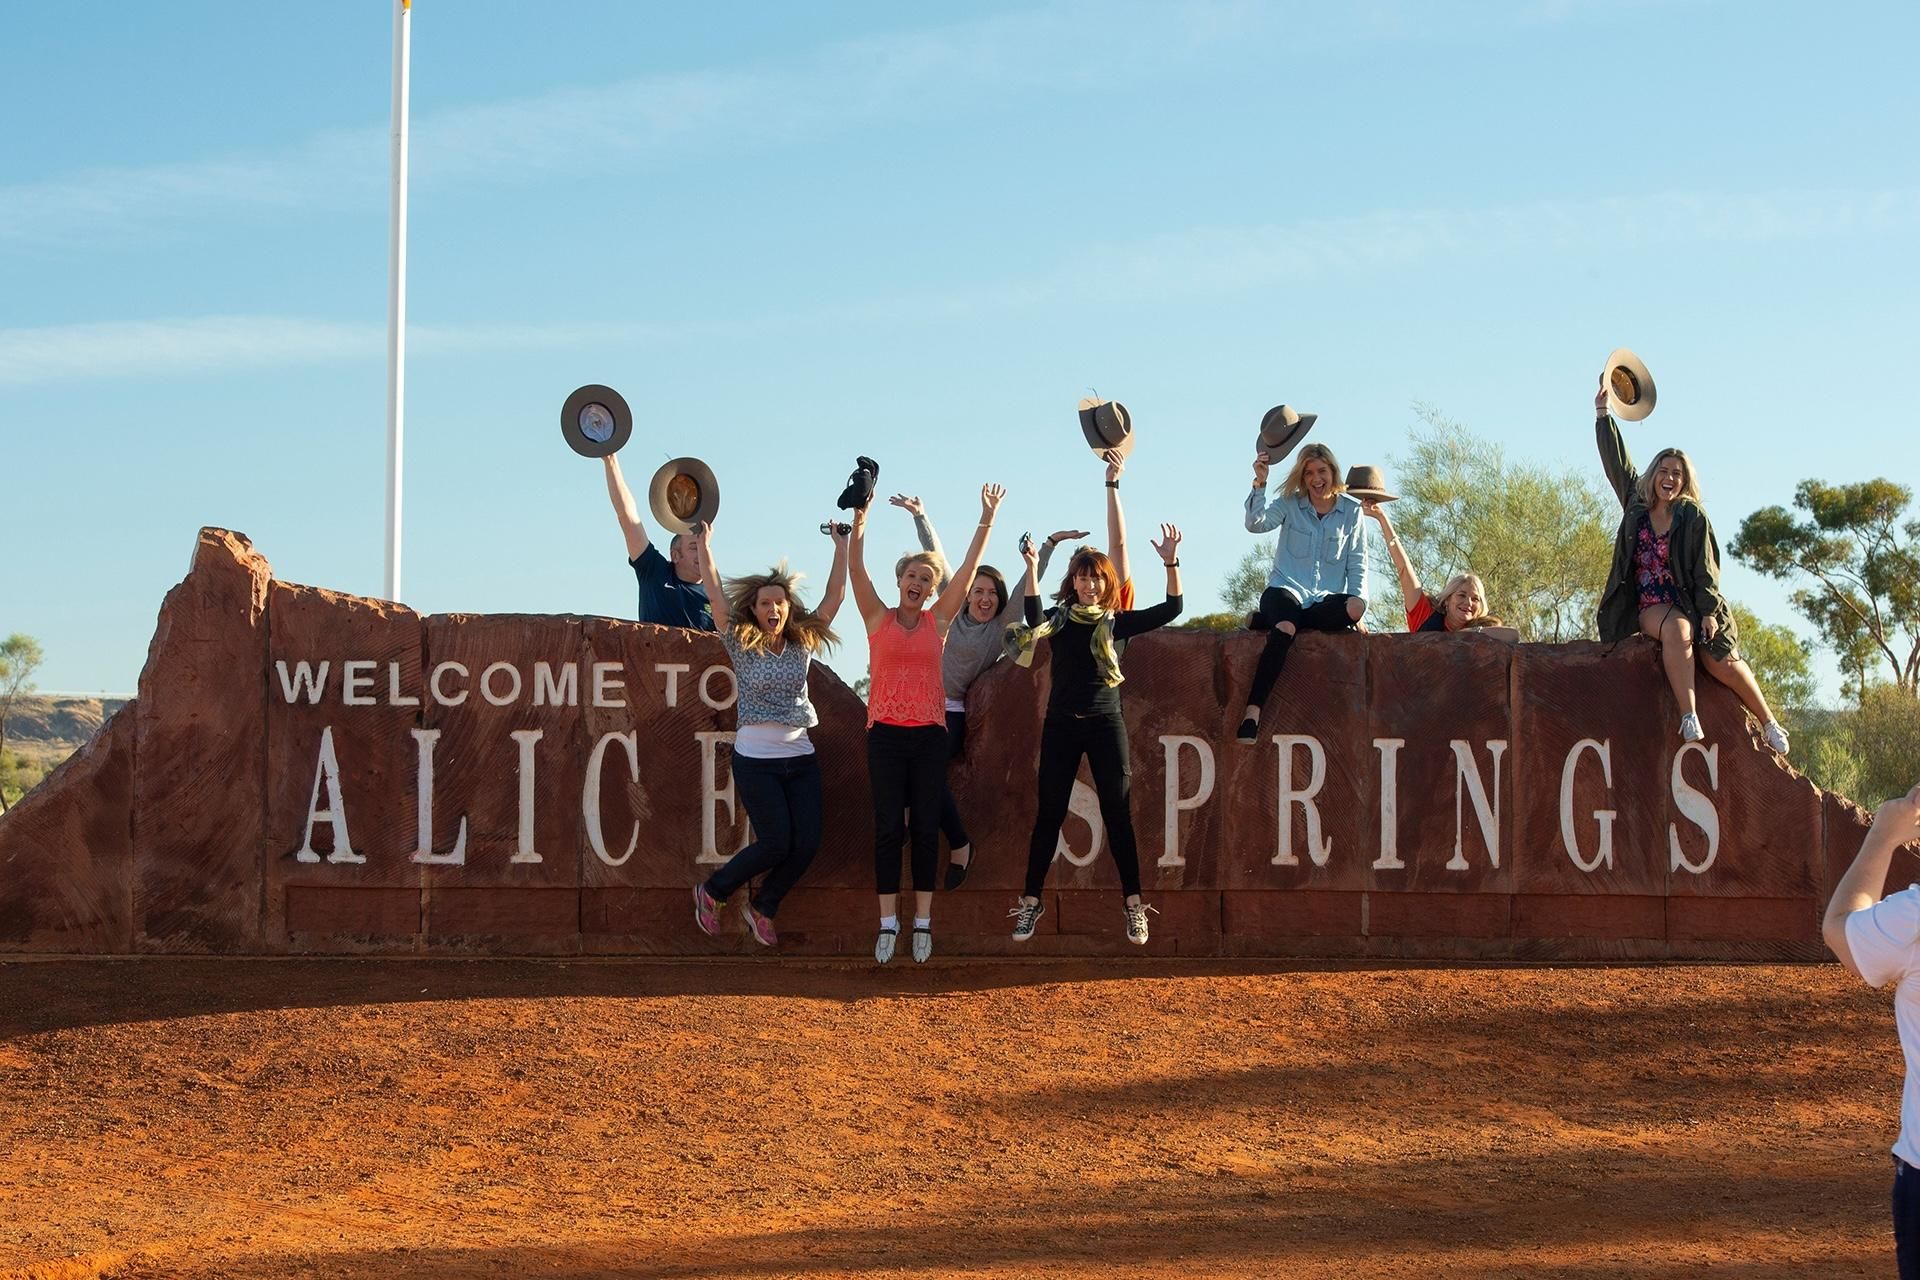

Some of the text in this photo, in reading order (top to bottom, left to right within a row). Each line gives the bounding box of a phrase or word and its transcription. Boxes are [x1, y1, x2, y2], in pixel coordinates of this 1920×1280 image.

[275, 660, 739, 711] WELCOME TO
[296, 725, 749, 867] ALICE
